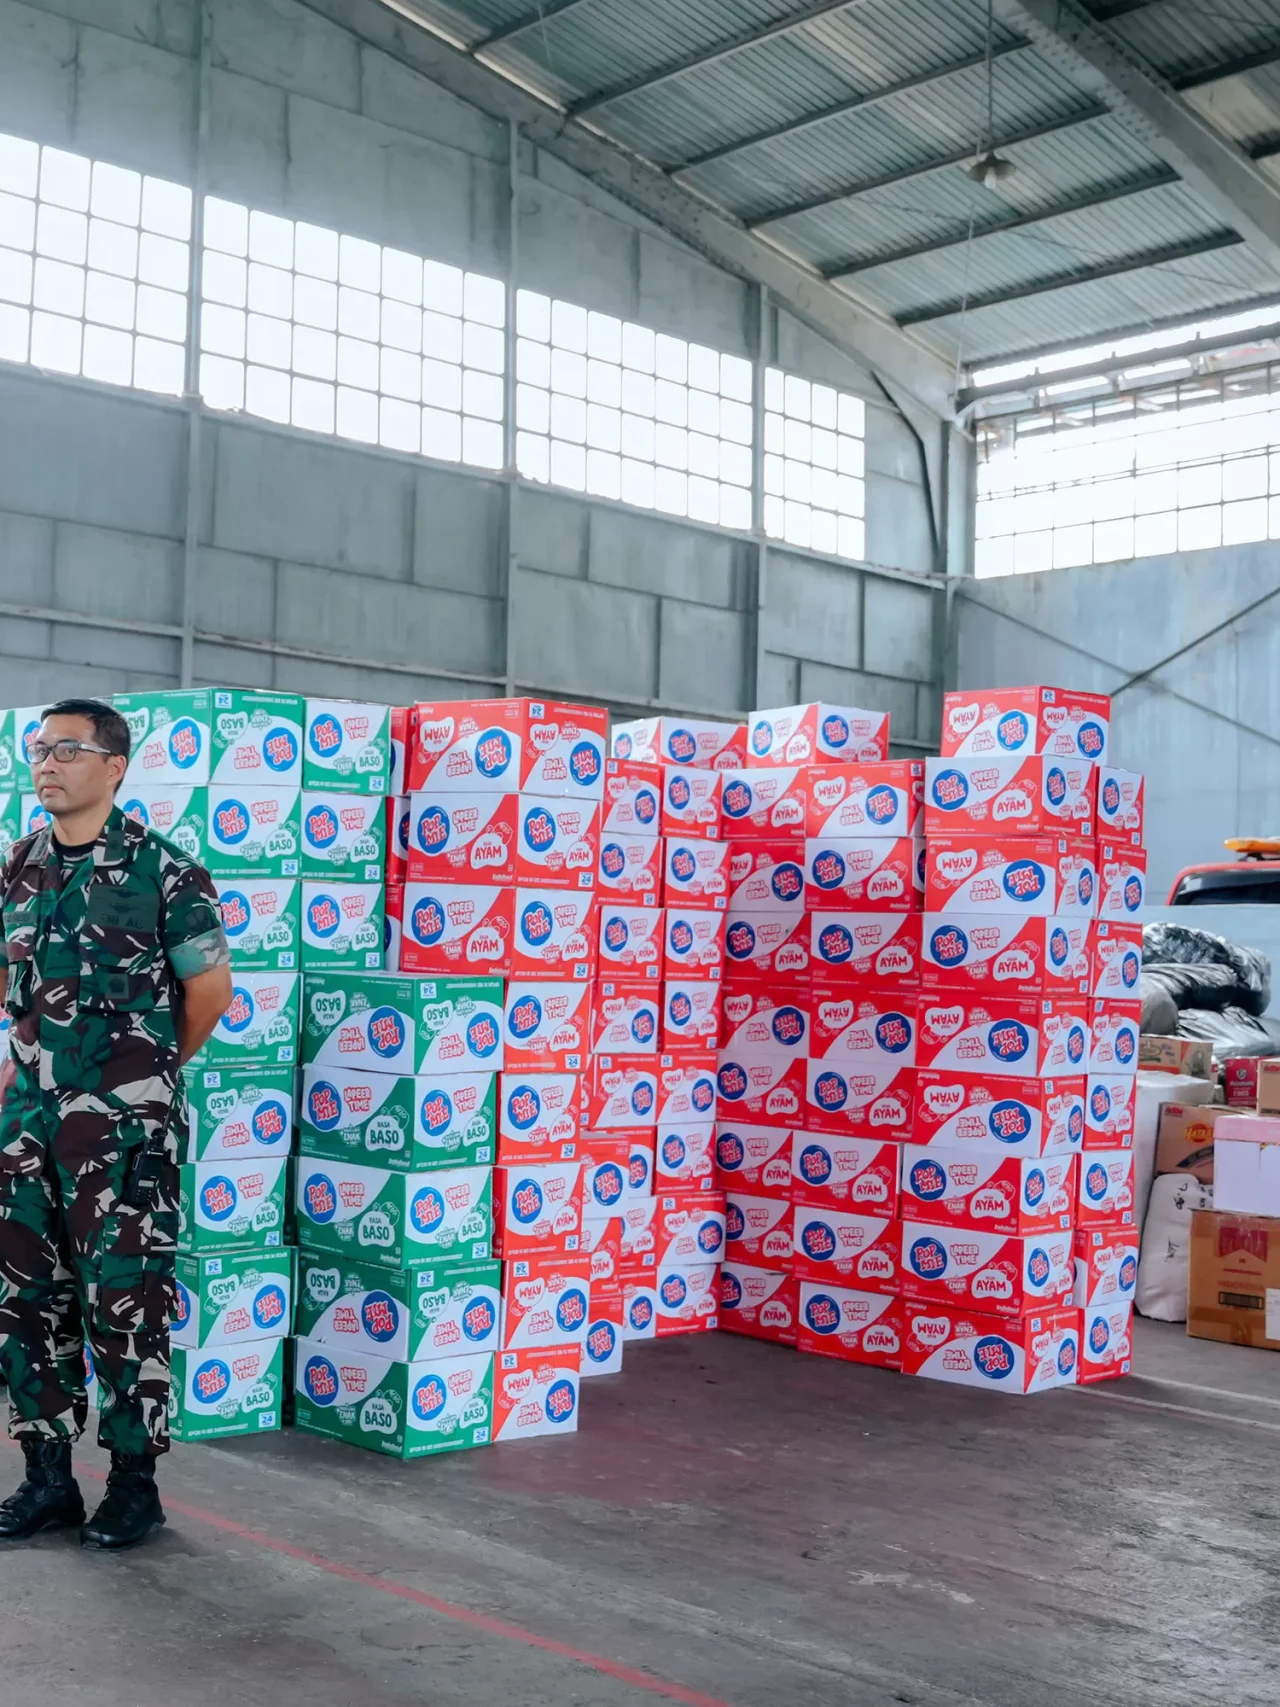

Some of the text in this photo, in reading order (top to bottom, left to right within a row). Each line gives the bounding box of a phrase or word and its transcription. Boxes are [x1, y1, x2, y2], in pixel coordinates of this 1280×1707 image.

[424, 724, 449, 737] AYAM
[532, 730, 553, 739] AYAM
[359, 758, 380, 768] BASO
[485, 749, 505, 769] POP
[578, 759, 596, 776] POP
[371, 781, 382, 789] 24
[936, 775, 956, 793] POP
[941, 785, 965, 804] MIE
[997, 802, 1026, 813] AYAM
[218, 807, 239, 827] POP
[422, 814, 439, 833] POP
[223, 820, 248, 838] MIE
[455, 820, 476, 834] TIME
[528, 816, 546, 834] POP
[425, 825, 446, 846] MIE
[533, 829, 553, 846] MIE
[269, 840, 293, 852] BASO
[354, 847, 375, 857] BASO
[475, 848, 502, 860] AYAM
[571, 853, 590, 863] AYAM
[941, 855, 971, 866] AYAM
[284, 864, 295, 872] 24
[582, 875, 592, 884] 24
[1016, 877, 1038, 895] POP
[872, 882, 898, 892] AYAM
[416, 905, 434, 924] POP
[450, 913, 472, 926] TIME
[525, 910, 543, 928] POP
[420, 917, 441, 937] MIE
[530, 922, 550, 940] MIE
[356, 934, 375, 945] BASO
[823, 930, 842, 946] POP
[935, 932, 955, 948] POP
[974, 938, 998, 950] TIME
[471, 942, 498, 953] AYAM
[567, 944, 586, 955] AYAM
[828, 940, 849, 957] MIE
[940, 942, 964, 960] MIE
[880, 958, 907, 968] AYAM
[998, 963, 1028, 973] AYAM
[315, 997, 340, 1007] BASO
[425, 1005, 448, 1018] BASO
[930, 1012, 958, 1022] AYAM
[378, 1030, 398, 1049] POP
[475, 1029, 494, 1049] POP
[555, 1035, 577, 1046] AYAM
[1000, 1038, 1022, 1054] POP
[312, 1089, 330, 1107] POP
[929, 1091, 958, 1099] AYAM
[316, 1102, 338, 1121] MIE
[347, 1100, 369, 1112] TIME
[425, 1097, 443, 1118] POP
[457, 1097, 475, 1113] TIME
[429, 1109, 450, 1130] MIE
[467, 1127, 486, 1140] BASO
[1001, 1119, 1024, 1135] POP
[370, 1133, 399, 1144] BASO
[478, 1151, 487, 1159] 24
[915, 1166, 934, 1181] POP
[308, 1182, 326, 1199] POP
[856, 1187, 882, 1195] AYAM
[919, 1177, 942, 1193] MIE
[312, 1196, 333, 1214] MIE
[341, 1195, 362, 1207] TIME
[415, 1195, 435, 1216] POP
[449, 1193, 469, 1210] TIME
[975, 1202, 1004, 1211] AYAM
[255, 1212, 277, 1225] BASO
[420, 1206, 443, 1227] MIE
[363, 1228, 389, 1240] BASO
[462, 1223, 483, 1237] BASO
[806, 1228, 824, 1242] POP
[475, 1247, 485, 1255] 24
[811, 1238, 832, 1253] MIE
[915, 1244, 935, 1259] POP
[862, 1263, 888, 1271] AYAM
[920, 1256, 943, 1271] MIE
[953, 1255, 977, 1265] TIME
[310, 1273, 334, 1285] BASO
[976, 1282, 1006, 1292] AYAM
[421, 1292, 444, 1306] BASO
[372, 1316, 392, 1333] POP
[471, 1312, 490, 1333] POP
[917, 1322, 944, 1331] AYAM
[986, 1356, 1007, 1370] POP
[198, 1366, 219, 1387] POP
[309, 1365, 327, 1381] POP
[203, 1378, 227, 1398] MIE
[313, 1379, 335, 1395] MIE
[343, 1379, 365, 1392] TIME
[505, 1374, 528, 1388] AYAM
[247, 1393, 270, 1407] BASO
[417, 1382, 437, 1404] POP
[422, 1393, 444, 1415] MIE
[259, 1416, 271, 1425] 24
[365, 1414, 392, 1428] BASO
[463, 1408, 484, 1423] BASO
[476, 1431, 486, 1440] 24
